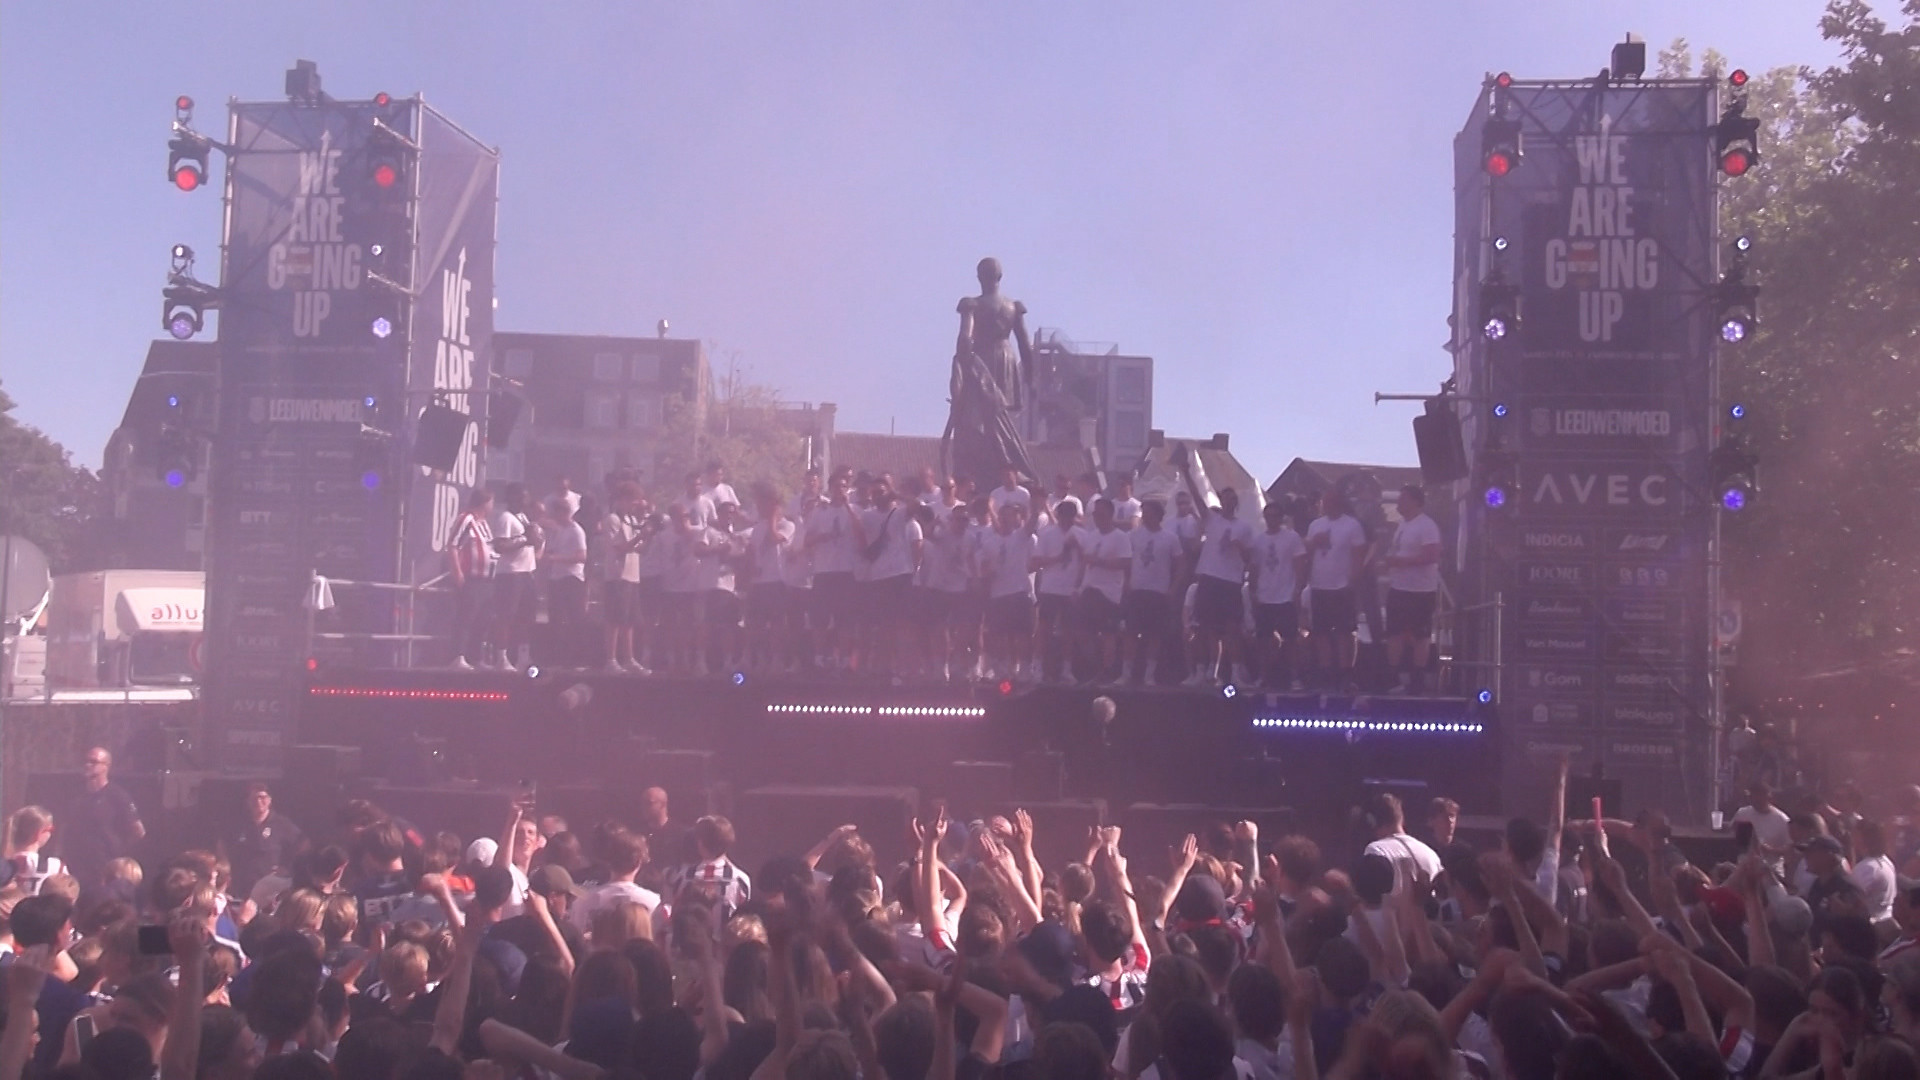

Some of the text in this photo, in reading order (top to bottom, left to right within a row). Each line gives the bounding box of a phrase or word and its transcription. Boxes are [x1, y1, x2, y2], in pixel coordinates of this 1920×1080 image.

[300, 129, 341, 195] WE
[1575, 113, 1628, 184] WE
[288, 197, 344, 242] ARE
[1568, 187, 1635, 237] ARE
[267, 243, 361, 291] GING
[1546, 238, 1658, 289] GING
[293, 291, 331, 337] UP
[442, 247, 472, 346] WE
[1579, 291, 1623, 342] UP
[1556, 410, 1670, 436] LEEUWENMOED
[1533, 473, 1667, 506] AVEC
[432, 483, 459, 551] UP
[1525, 533, 1584, 547] INDICIA
[1544, 671, 1582, 686] Gom
